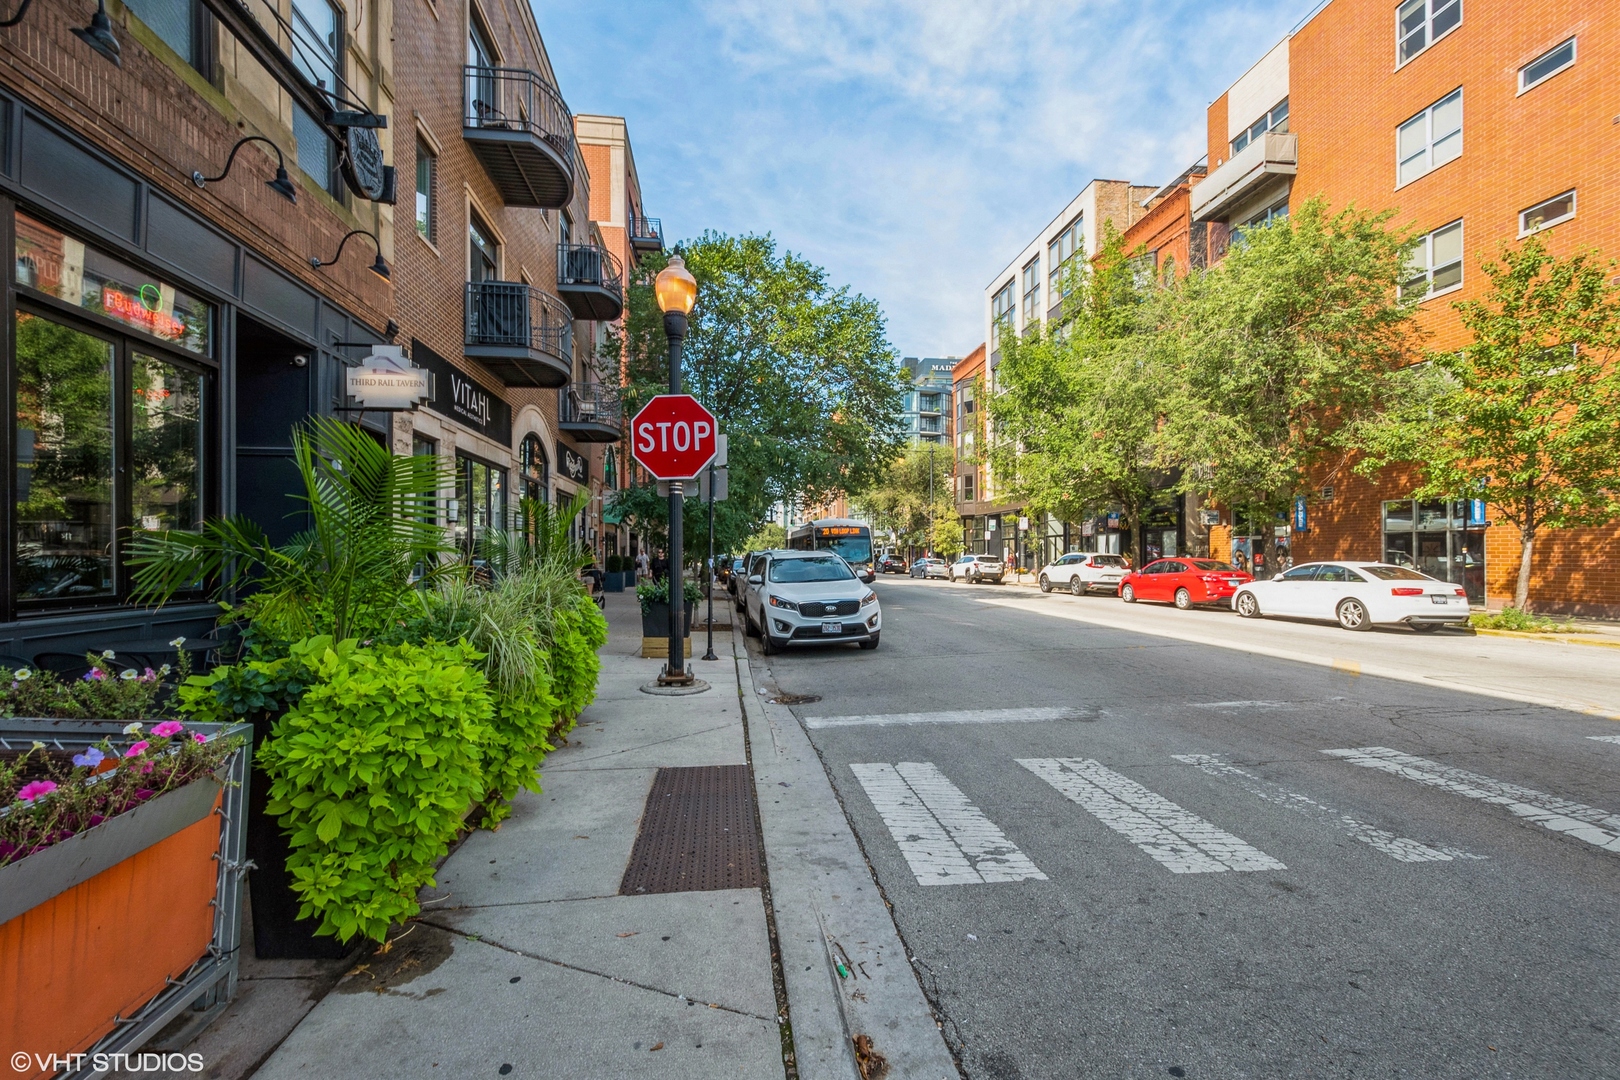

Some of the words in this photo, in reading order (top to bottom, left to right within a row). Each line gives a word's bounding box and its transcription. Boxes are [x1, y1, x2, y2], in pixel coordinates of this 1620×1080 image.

[114, 291, 186, 334] Budweiser
[350, 378, 376, 387] THIRD
[378, 379, 395, 387] RAIL
[396, 380, 425, 388] TAVERN
[451, 374, 491, 426] VITAHL
[638, 420, 711, 453] STOP
